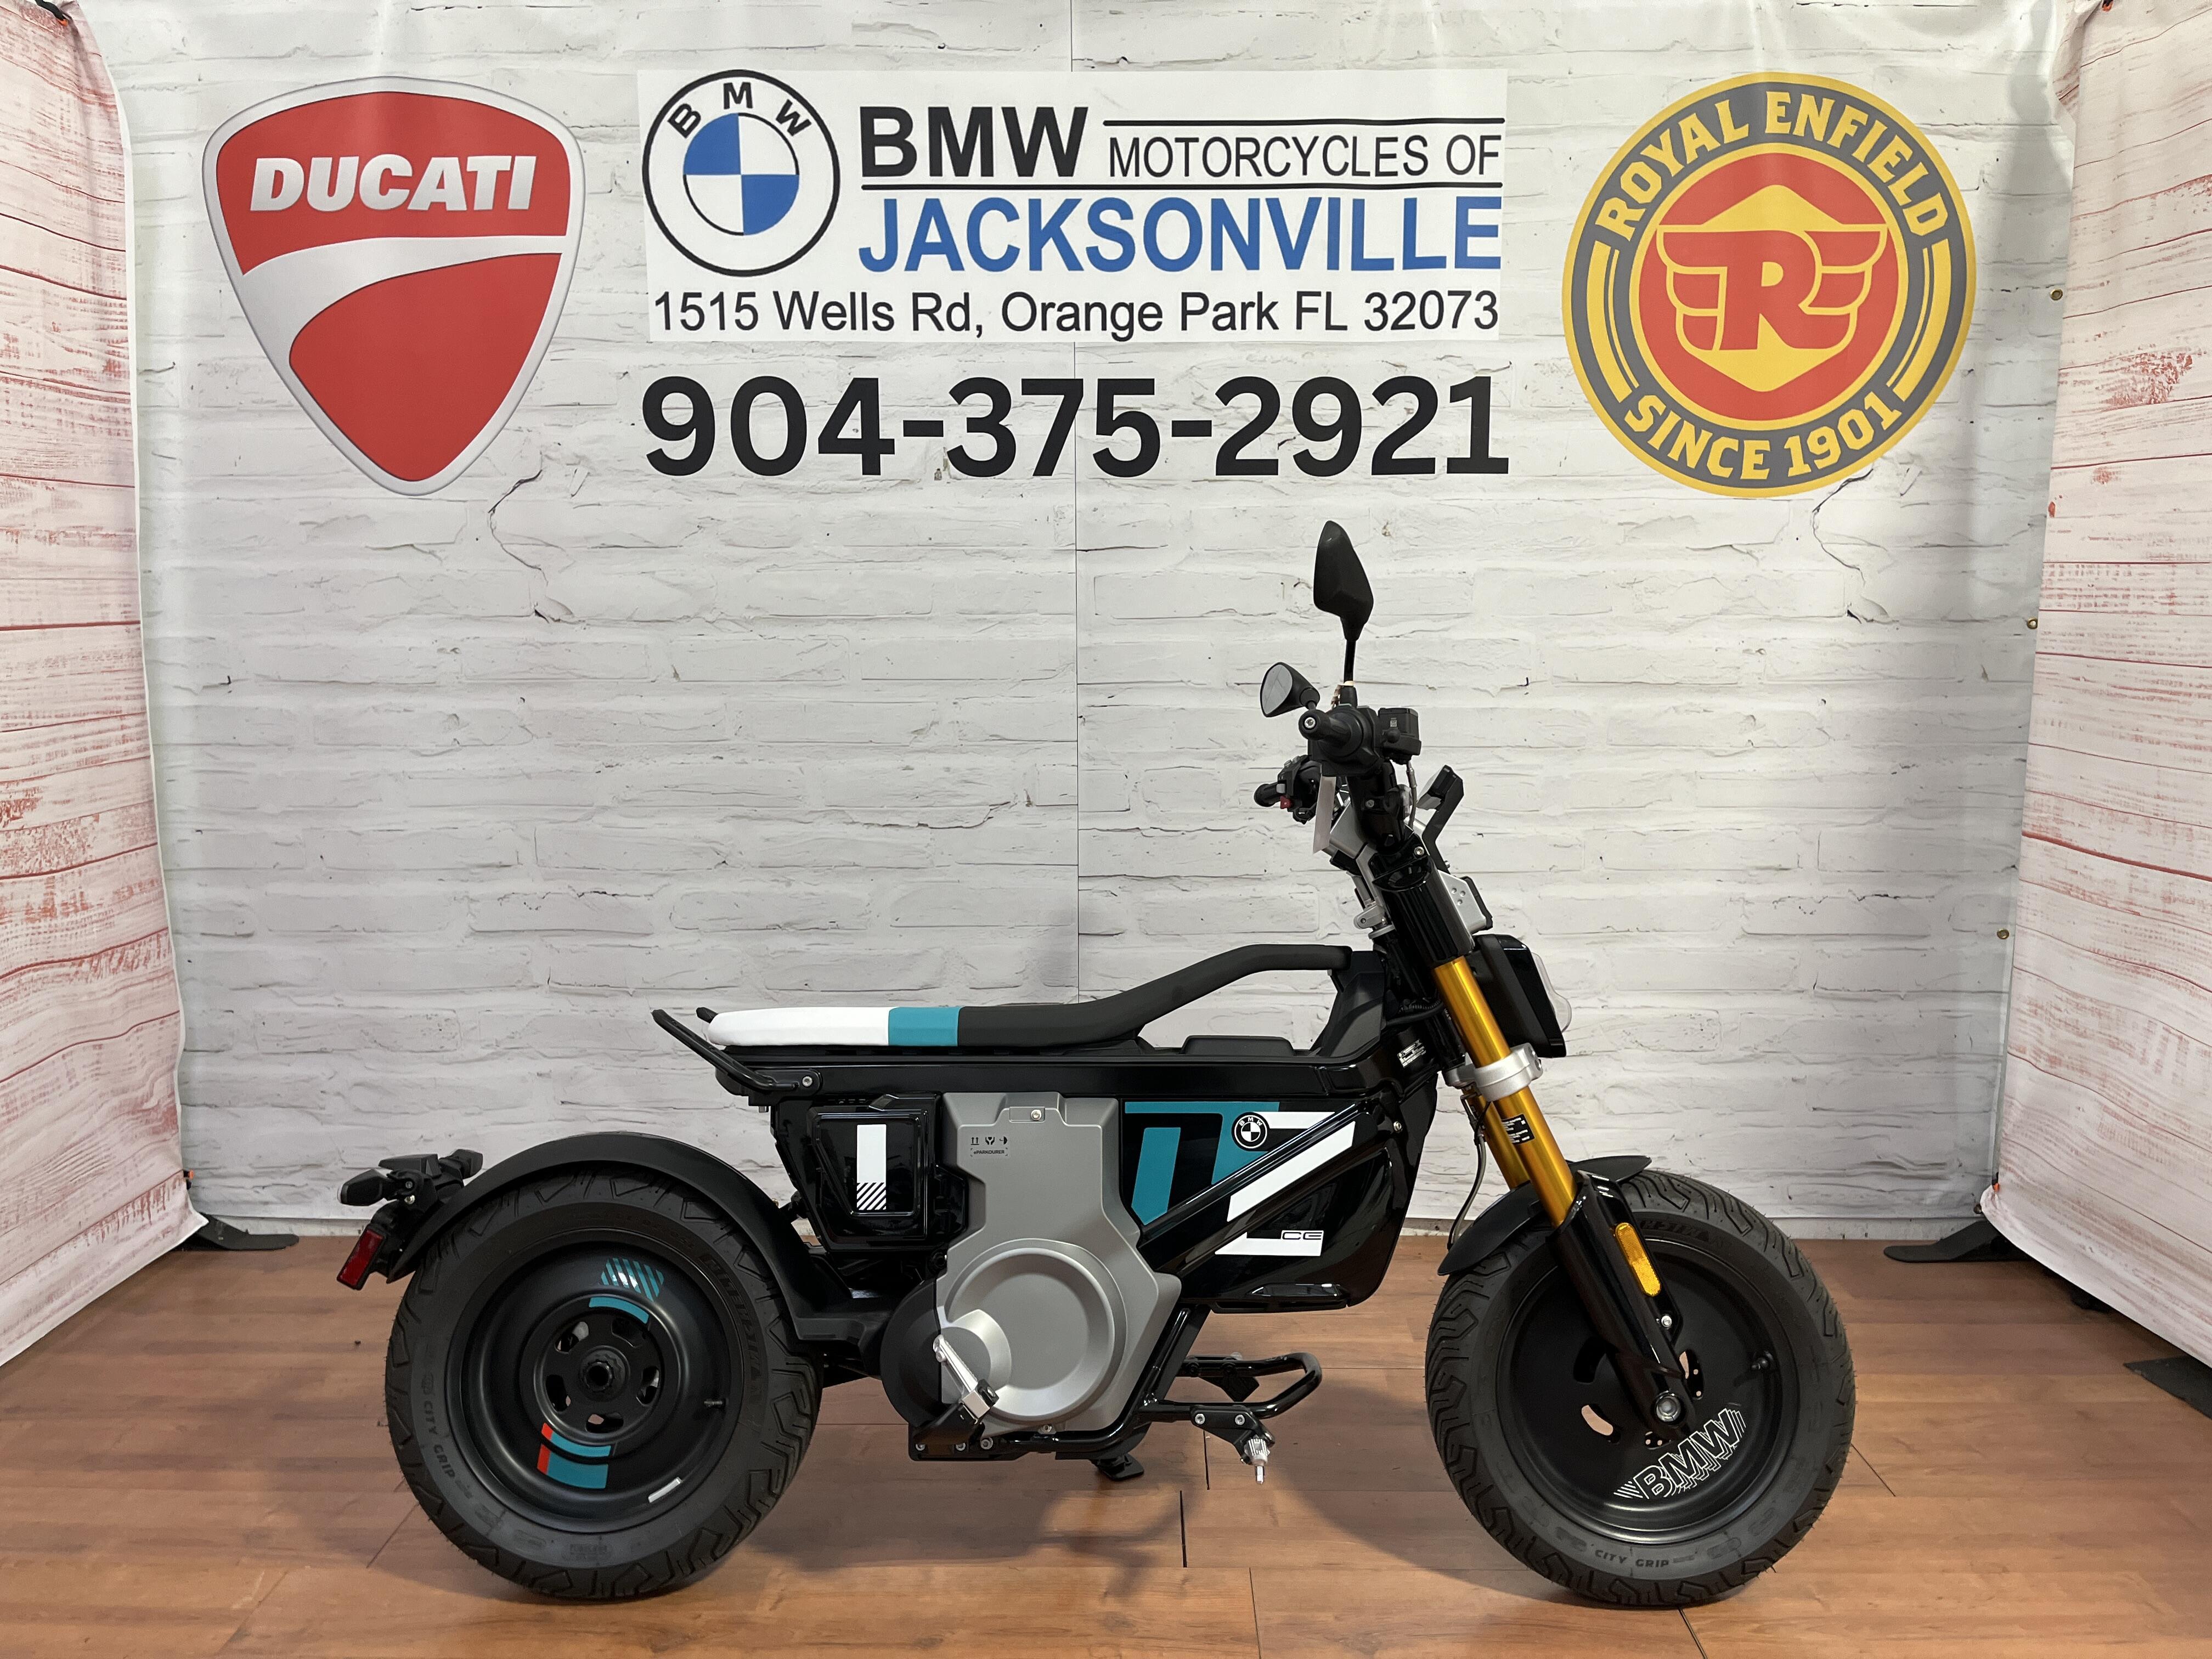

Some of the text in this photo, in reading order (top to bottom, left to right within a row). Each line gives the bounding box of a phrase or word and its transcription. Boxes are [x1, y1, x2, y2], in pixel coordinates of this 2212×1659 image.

[667, 81, 811, 138] BMW
[859, 106, 1502, 178] BMW MOTORCYCLES OF
[250, 154, 537, 212] DUCATI
[1594, 91, 1948, 241] ROYAL ENFIELD
[859, 196, 1502, 272] JACKSONVILLE
[654, 290, 1498, 342] 1515 Wells Rd, Orange Park FL 32073
[642, 376, 1509, 478] 904-375-2921
[1624, 391, 1902, 480] SINCE 1901
[1239, 1116, 1263, 1126] BMW
[1282, 1231, 1323, 1240] CE
[424, 1400, 438, 1435] CITY
[433, 1443, 456, 1477] GRIP
[1633, 1408, 1742, 1499] BMW
[1595, 1550, 1628, 1564] CITY
[1635, 1558, 1669, 1567] GRIP
